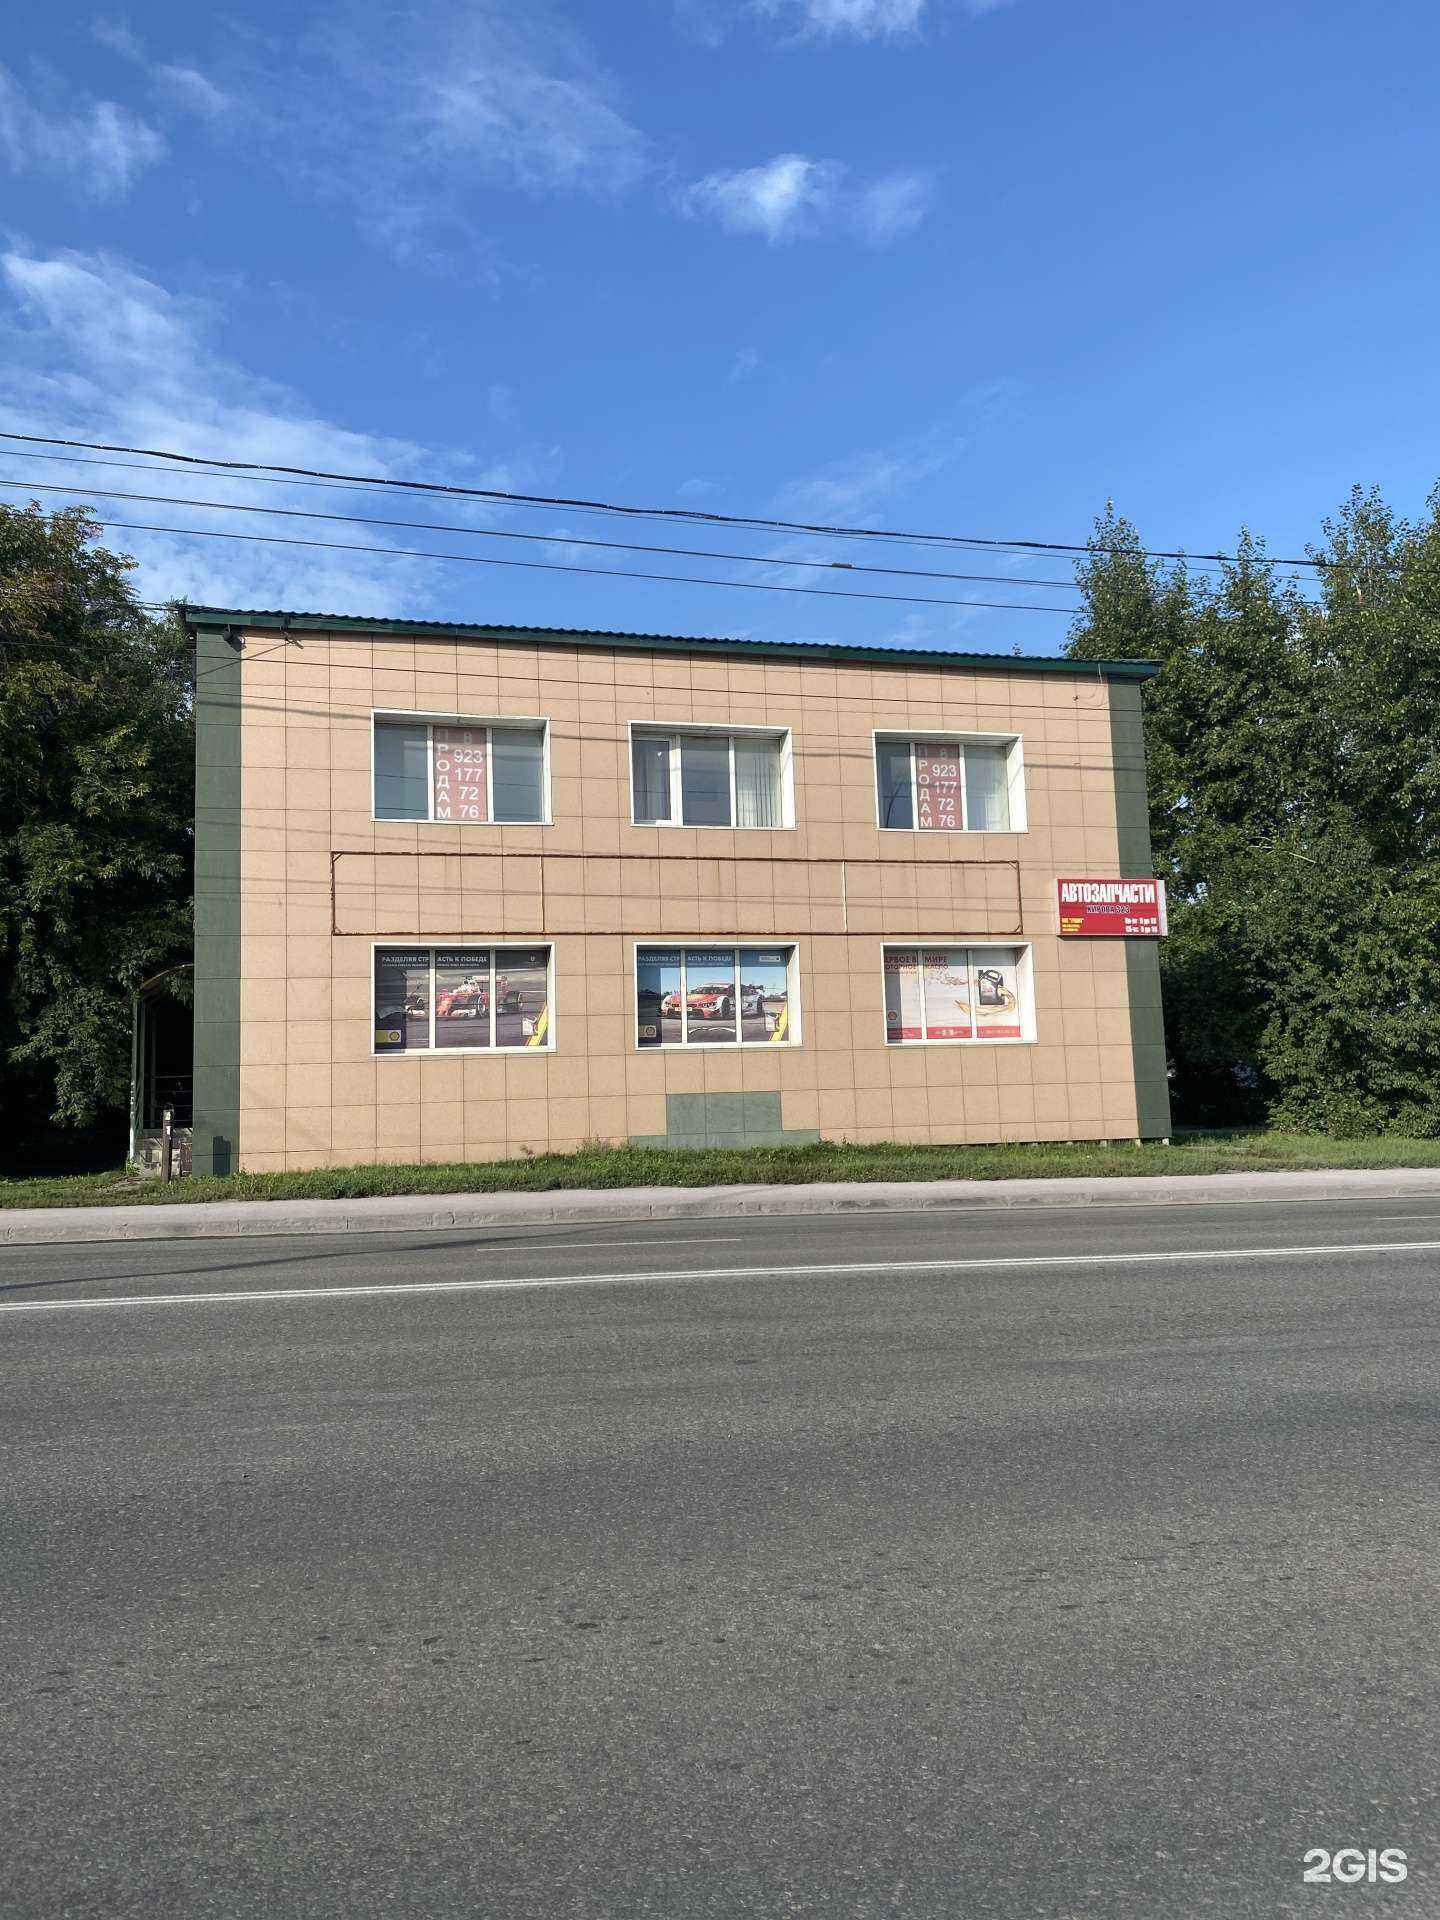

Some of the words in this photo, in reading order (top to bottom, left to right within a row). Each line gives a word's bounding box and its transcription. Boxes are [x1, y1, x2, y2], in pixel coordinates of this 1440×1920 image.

[453, 749, 483, 763] 923
[436, 728, 452, 818] ПРОДАМ
[455, 768, 483, 782] 177
[931, 764, 957, 777] 923
[918, 743, 933, 828] ПРОДАМ
[933, 781, 957, 794] 177
[459, 786, 479, 800] 72
[459, 804, 480, 818] 76
[938, 798, 955, 811] 72
[938, 815, 956, 827] 76
[1061, 882, 1156, 904] АВТОЗАПЧАСТИ
[1087, 904, 1115, 914] КИРОВА
